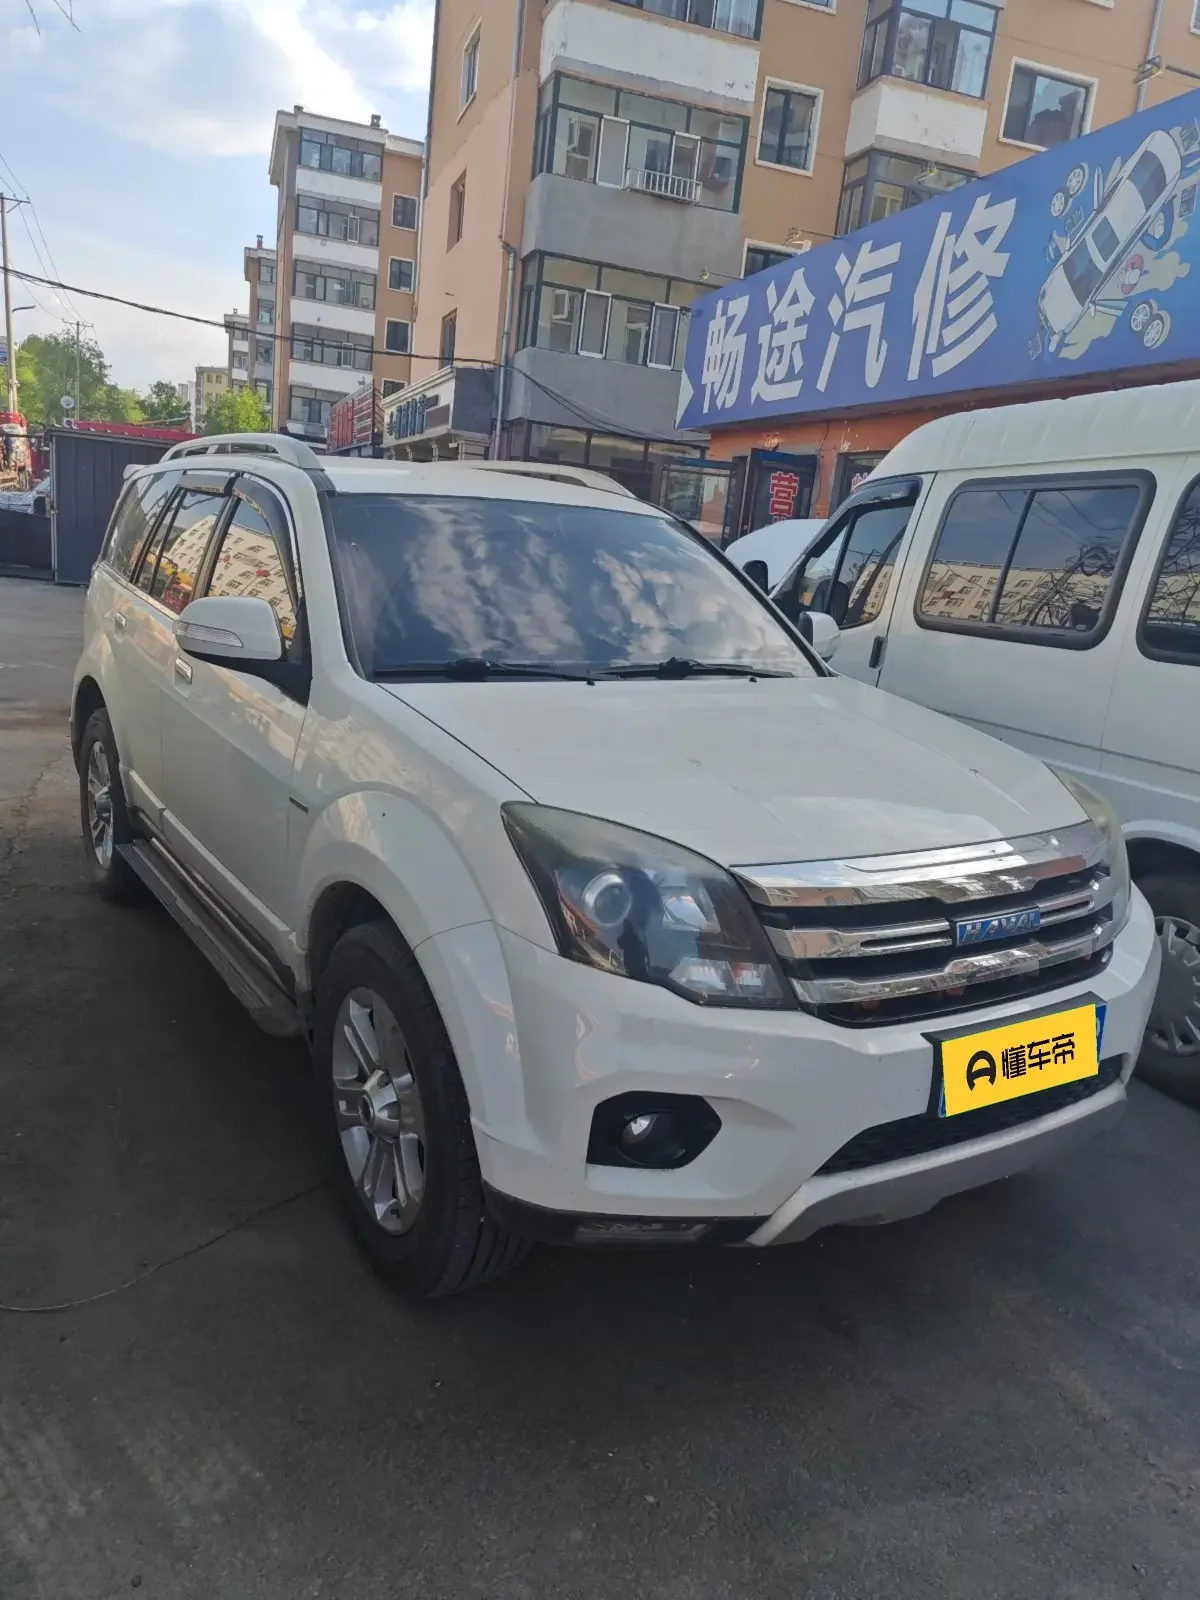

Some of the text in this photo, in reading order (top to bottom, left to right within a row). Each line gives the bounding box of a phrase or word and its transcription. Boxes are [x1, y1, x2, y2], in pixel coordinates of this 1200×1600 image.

[701, 193, 1016, 414] 畅途汽修
[961, 912, 1040, 942] HAVAL
